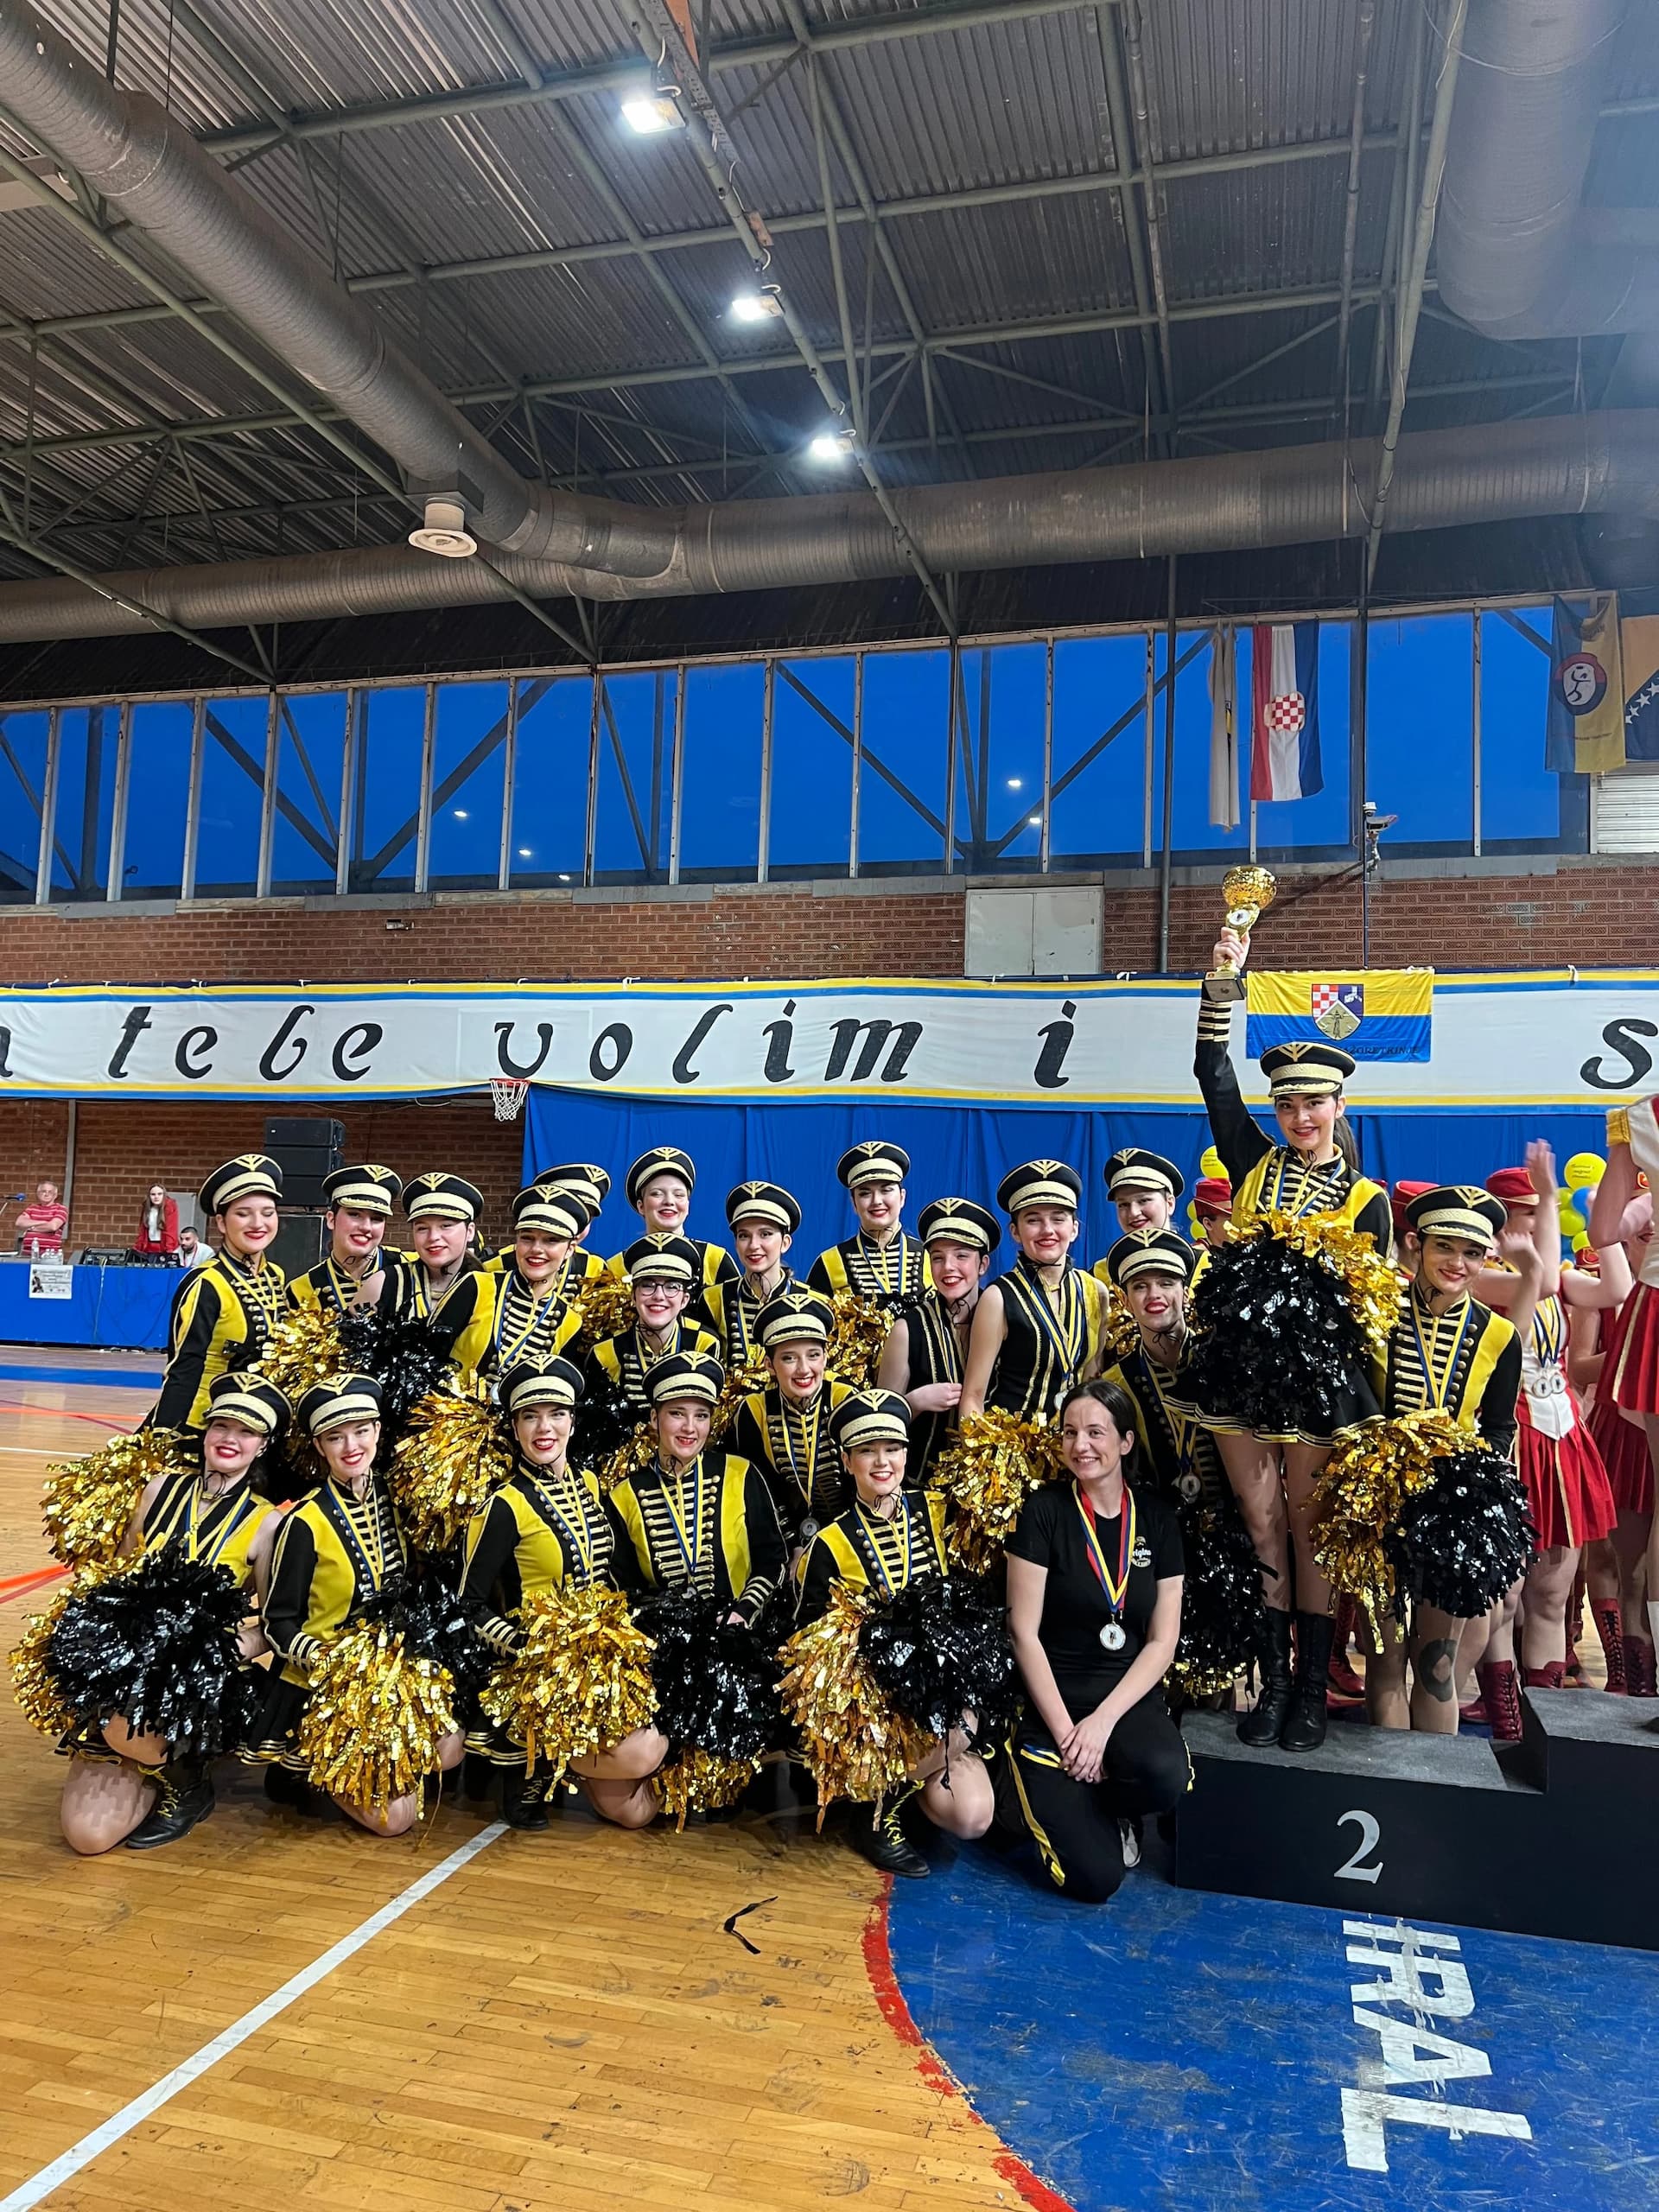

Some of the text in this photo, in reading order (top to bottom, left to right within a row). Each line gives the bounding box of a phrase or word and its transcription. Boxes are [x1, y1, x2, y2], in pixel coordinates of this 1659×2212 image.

[108, 1005, 383, 1081] tebe
[494, 999, 923, 1084] volim
[1033, 1000, 1077, 1089] i
[1333, 1809, 1384, 1885] 2
